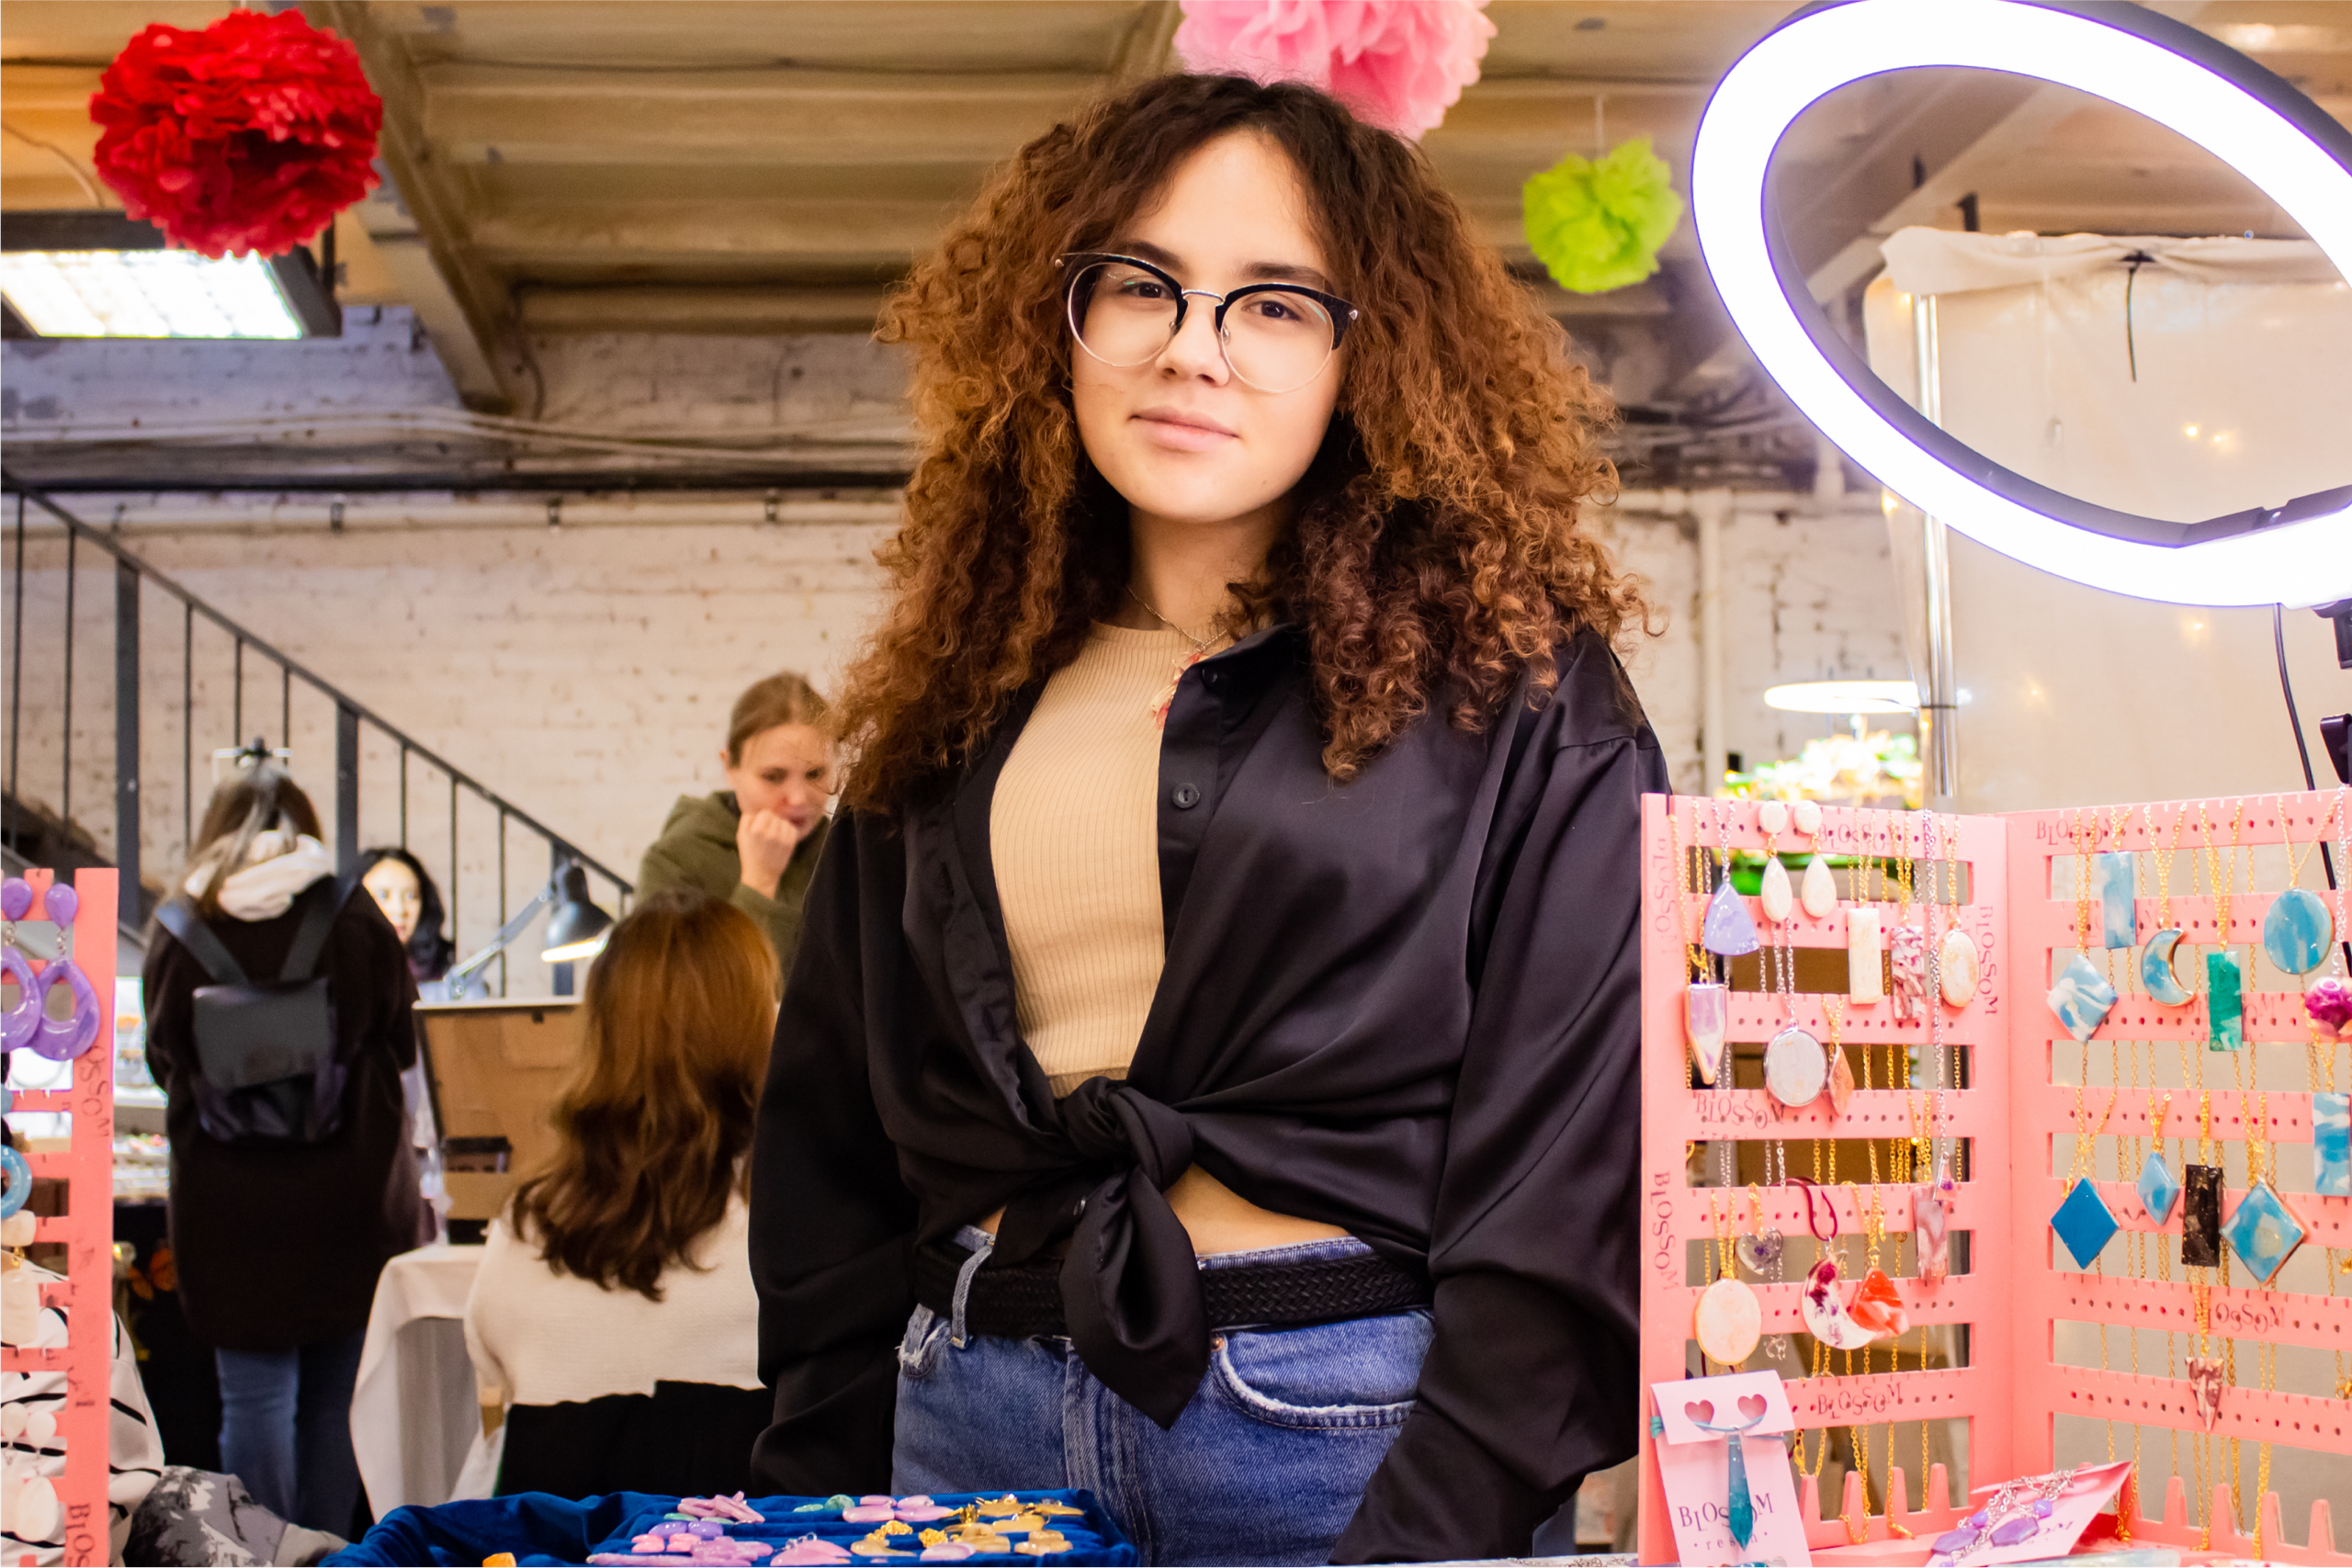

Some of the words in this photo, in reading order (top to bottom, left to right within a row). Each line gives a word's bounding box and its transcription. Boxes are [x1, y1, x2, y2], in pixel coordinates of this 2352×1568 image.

[1975, 906, 1997, 1015] BLOSSOM
[1694, 1092, 1786, 1130] BLOSSOM
[1650, 1170, 1679, 1291] BLOSSOM
[1817, 1382, 1903, 1420] BLOSSOM
